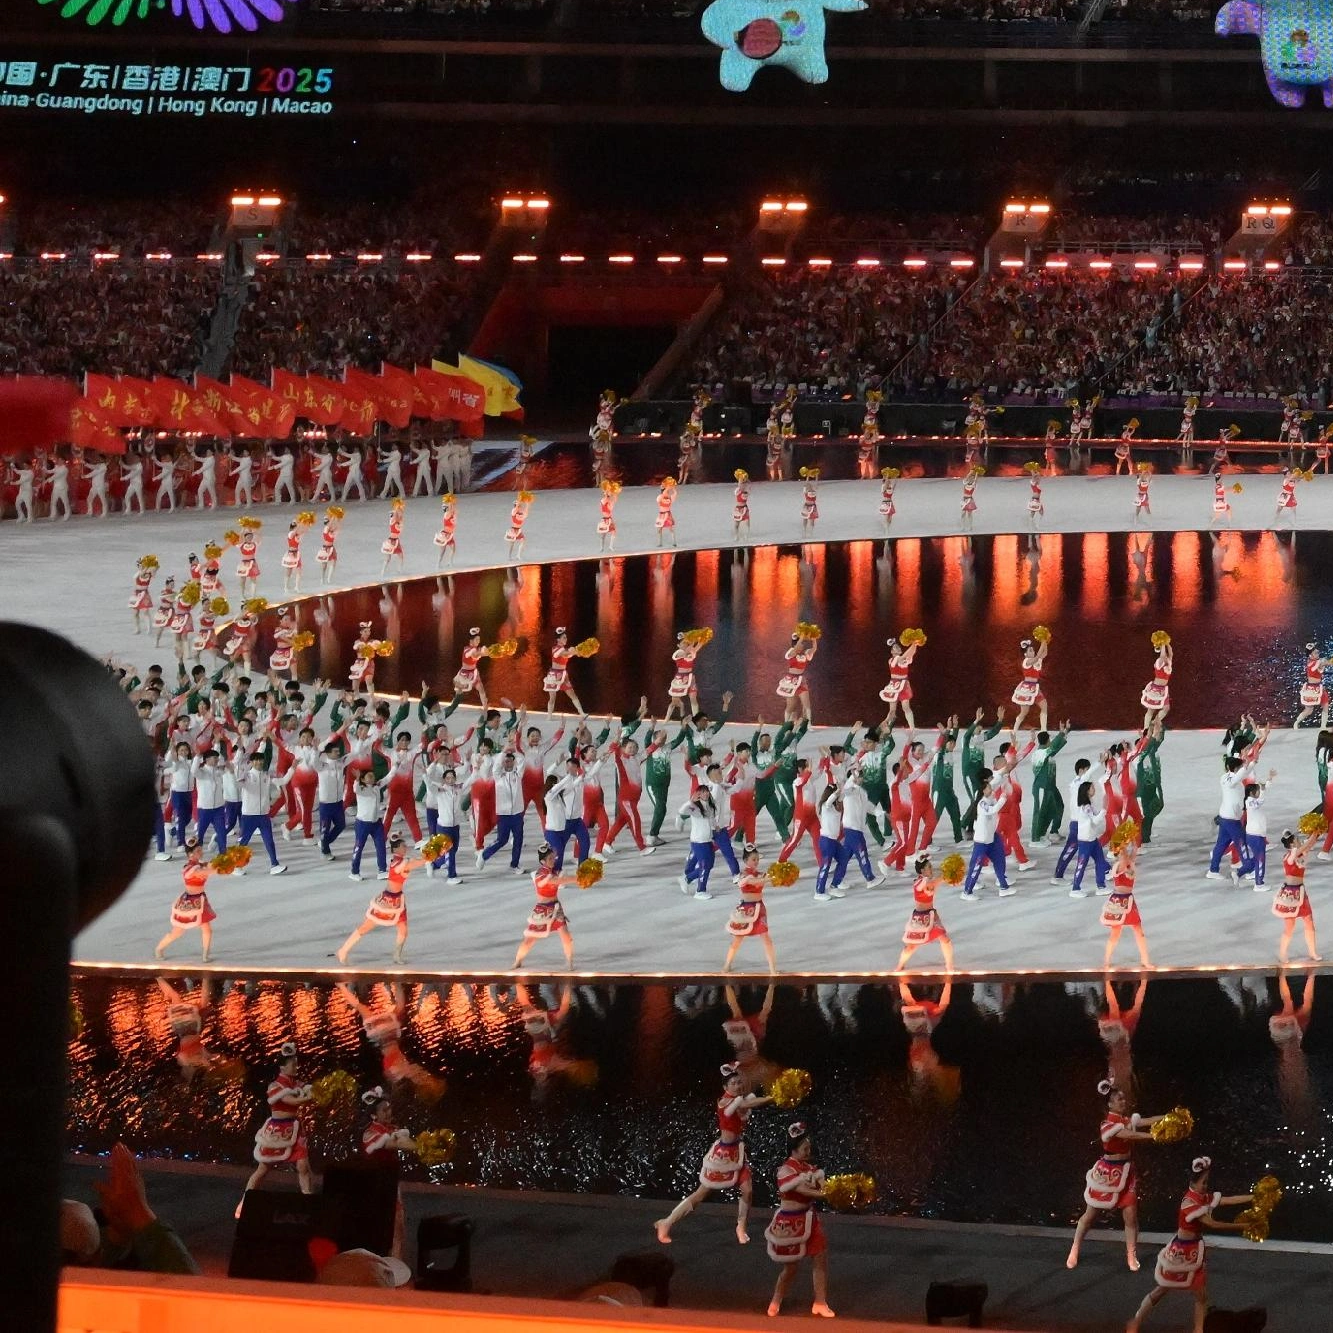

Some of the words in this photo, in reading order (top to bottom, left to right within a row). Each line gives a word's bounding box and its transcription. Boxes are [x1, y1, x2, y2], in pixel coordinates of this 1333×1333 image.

[257, 67, 333, 93] 2025
[158, 96, 206, 116] Hong
[210, 97, 258, 116] Kong
[271, 97, 333, 114] Macao
[1246, 217, 1257, 229] R
[1262, 217, 1275, 230] Q
